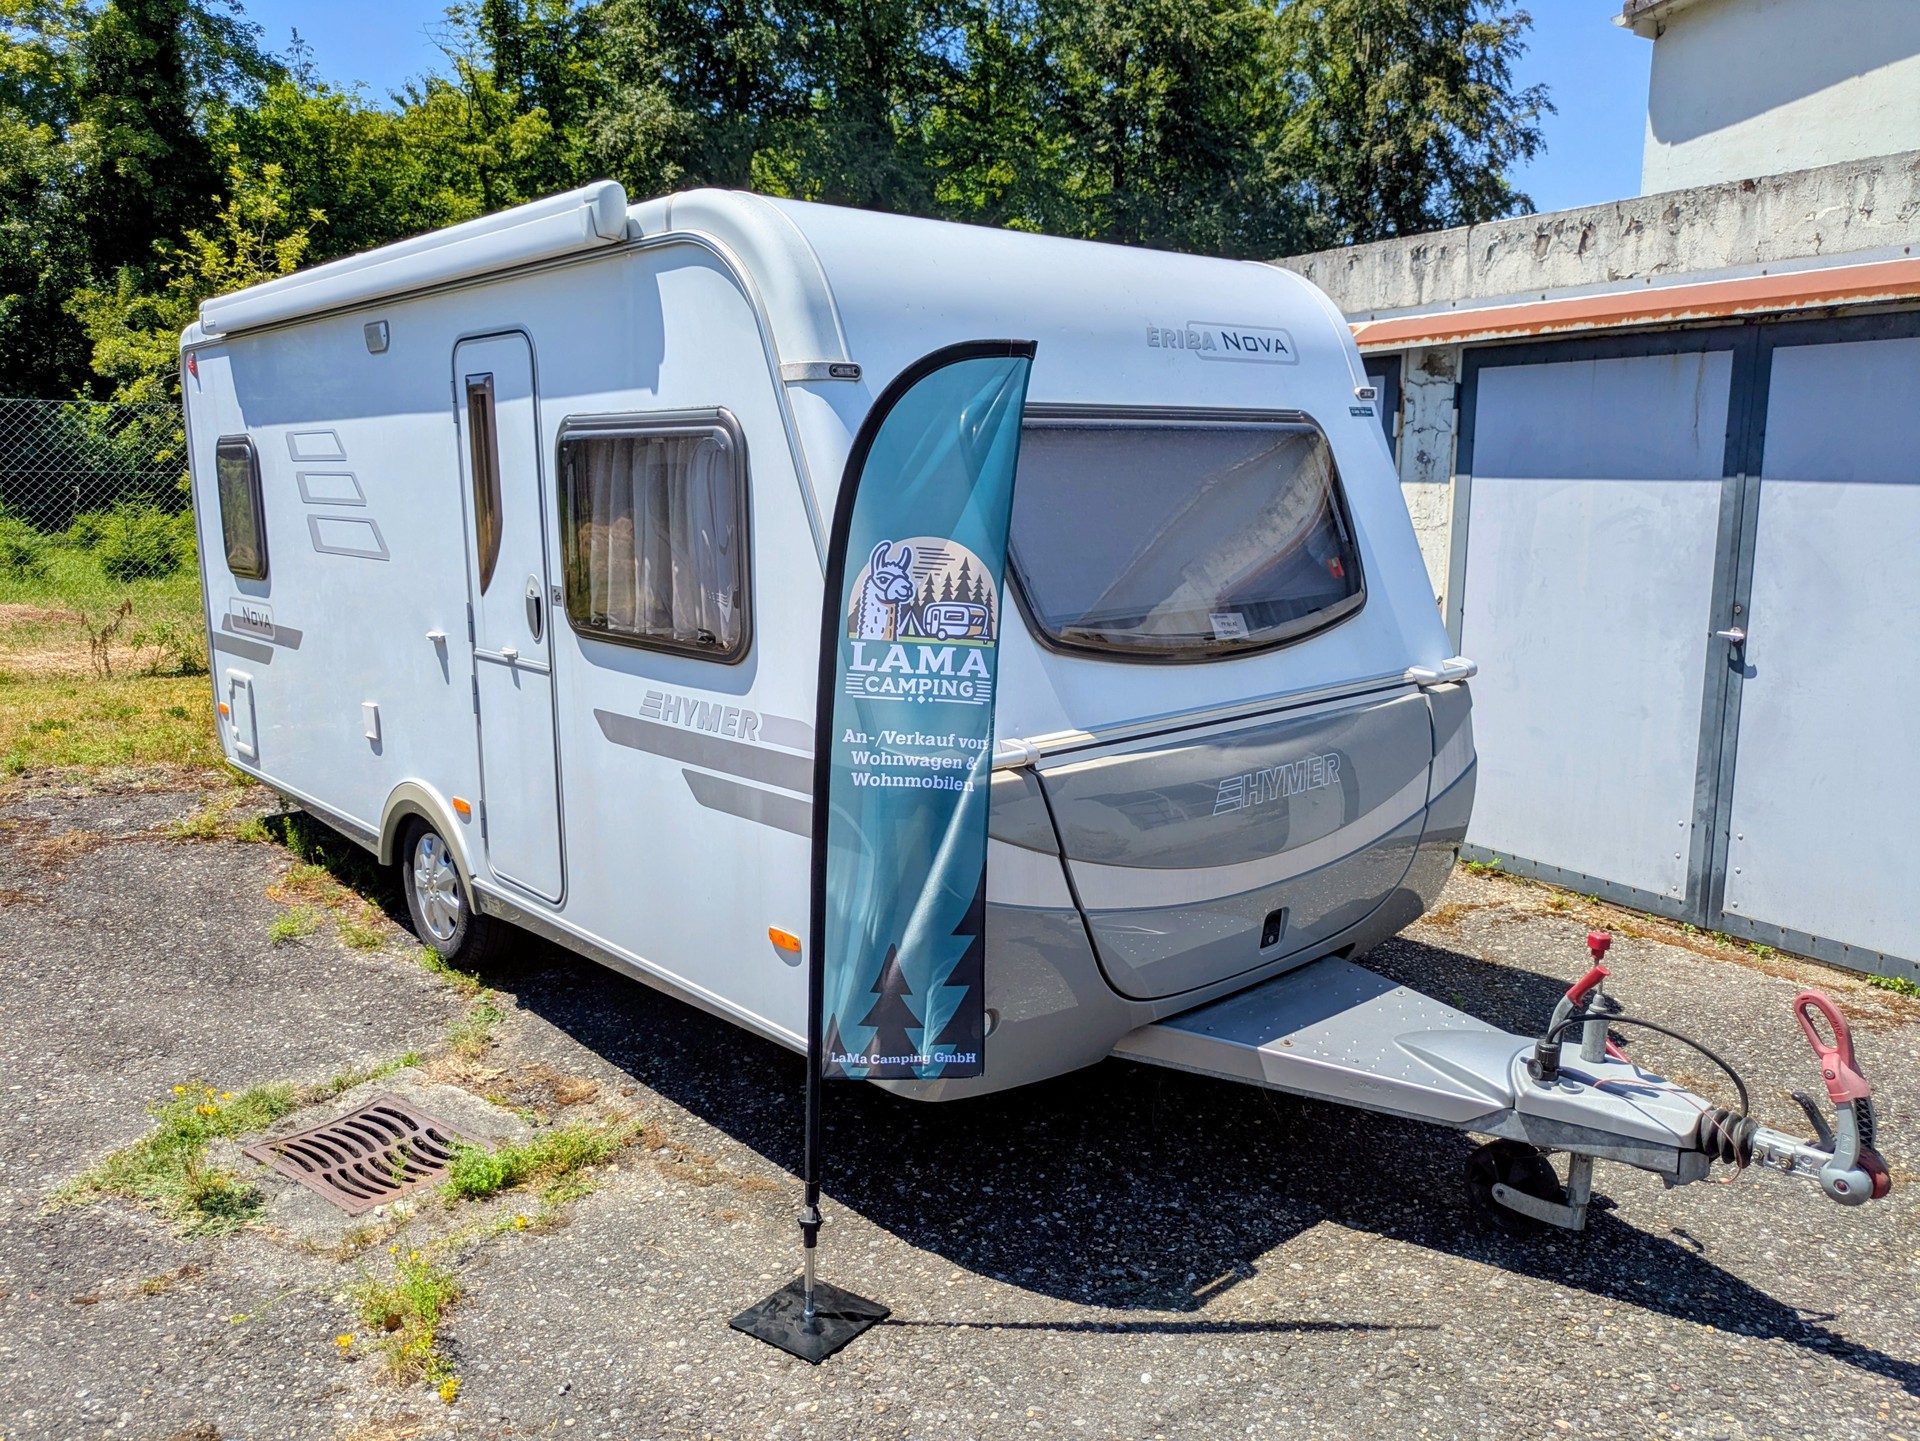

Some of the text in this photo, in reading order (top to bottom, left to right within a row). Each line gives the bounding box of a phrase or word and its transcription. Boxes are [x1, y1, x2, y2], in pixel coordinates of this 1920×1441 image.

[1146, 327, 1289, 354] ERIBA NOVA
[242, 606, 272, 630] NOVA
[849, 641, 990, 678] LAMA
[865, 676, 974, 697] CAMPING
[842, 728, 988, 751] An-/Verkauf von
[851, 750, 977, 772] Wohnwagen &
[851, 772, 975, 792] Wohnmobilen
[831, 1052, 976, 1065] LaMa Camping GmbH
